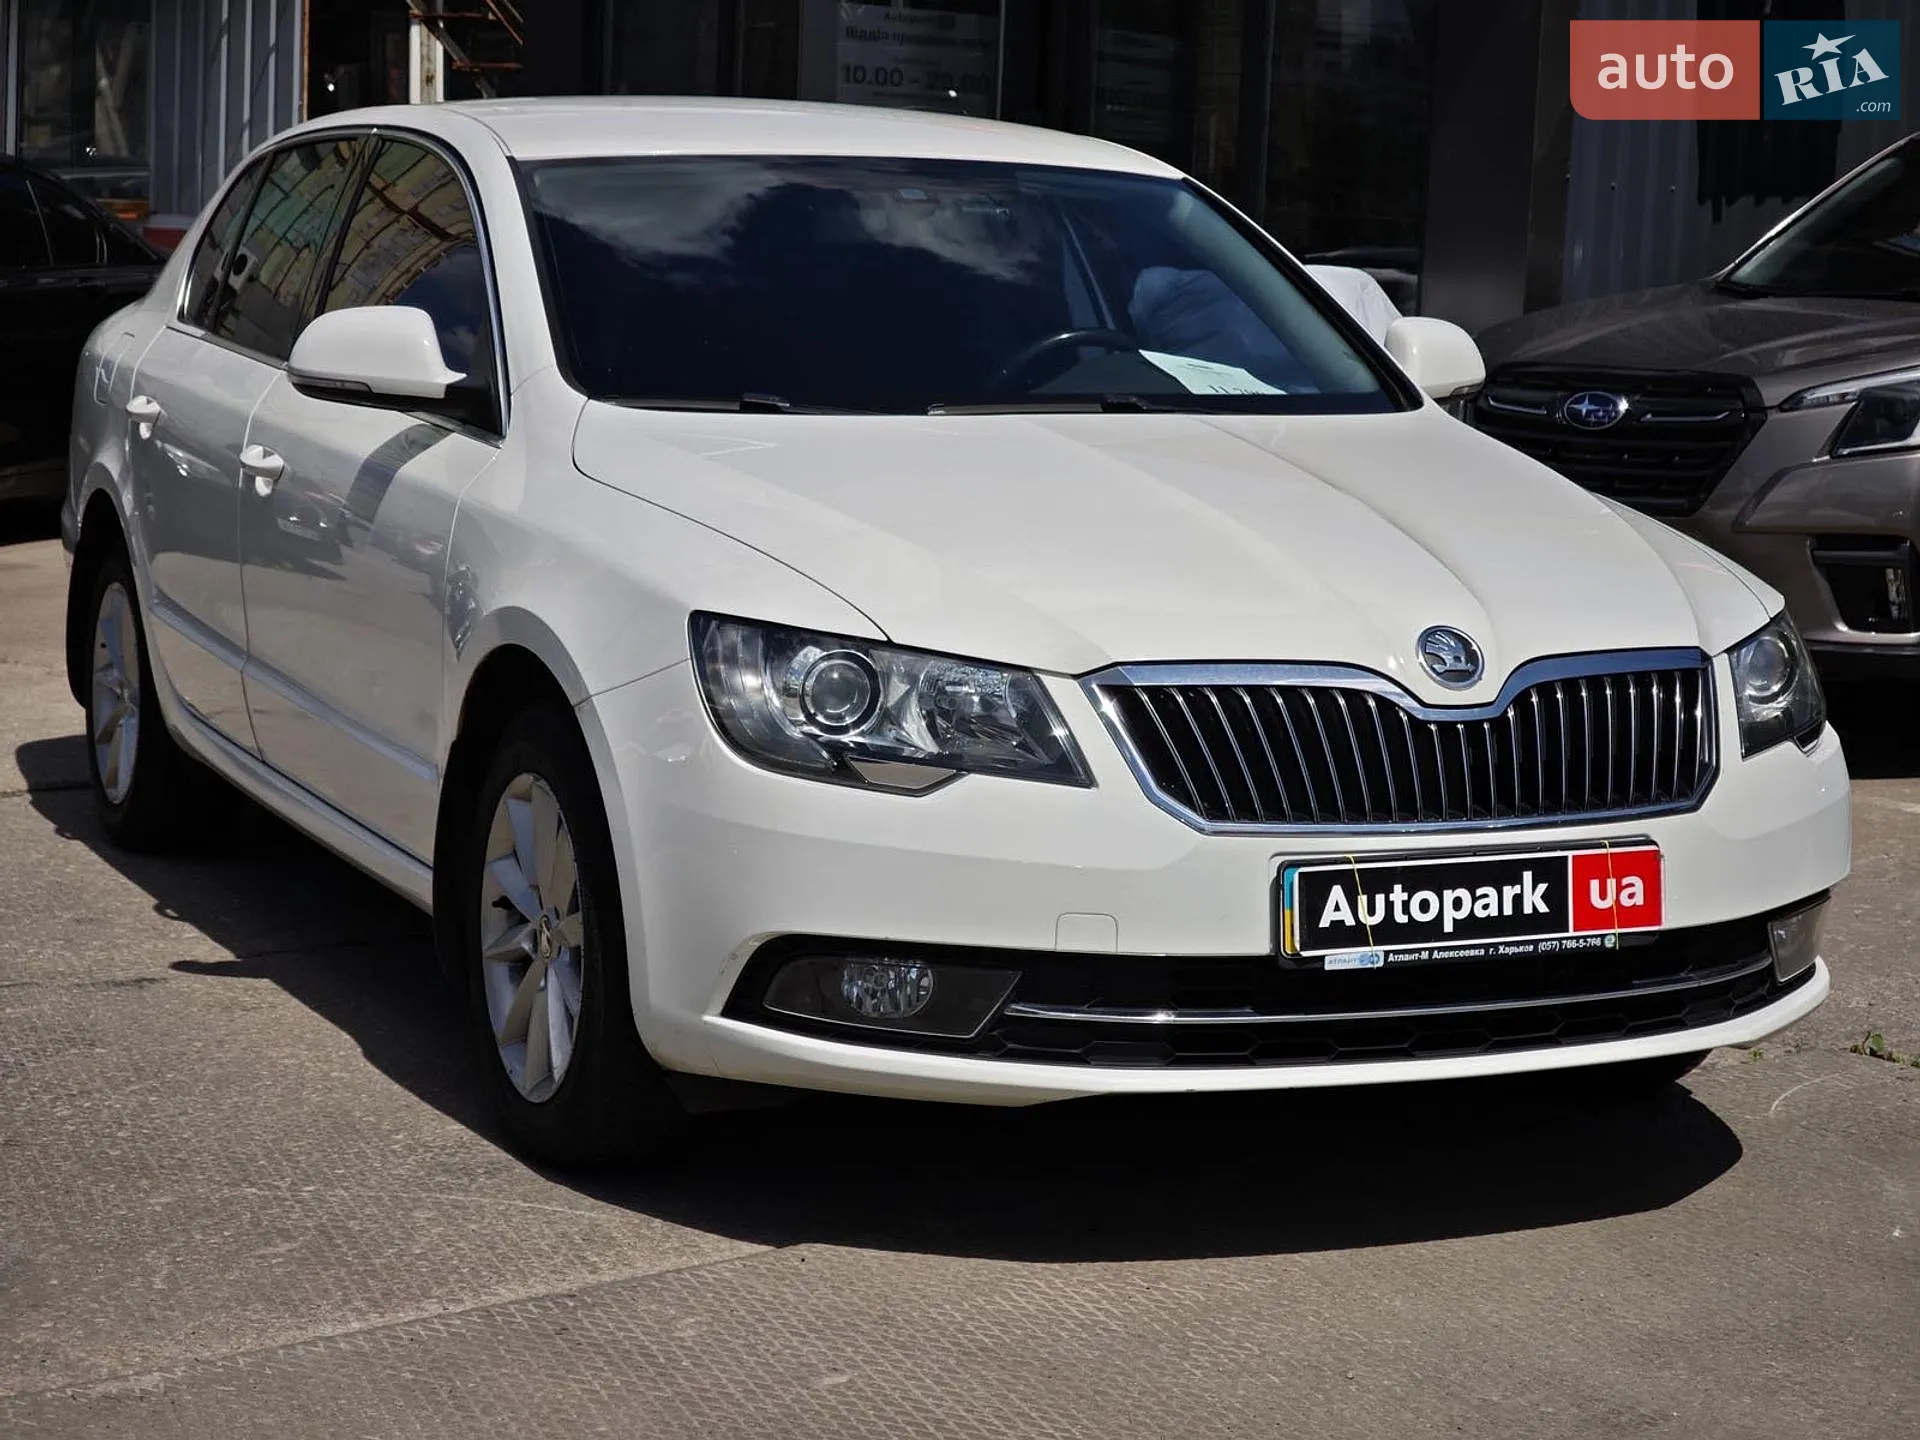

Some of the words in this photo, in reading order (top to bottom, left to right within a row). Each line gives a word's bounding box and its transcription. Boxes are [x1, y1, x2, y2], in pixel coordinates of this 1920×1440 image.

[840, 63, 904, 87] 10.00
[1318, 870, 1550, 933] Autopark
[1589, 875, 1644, 909] ua
